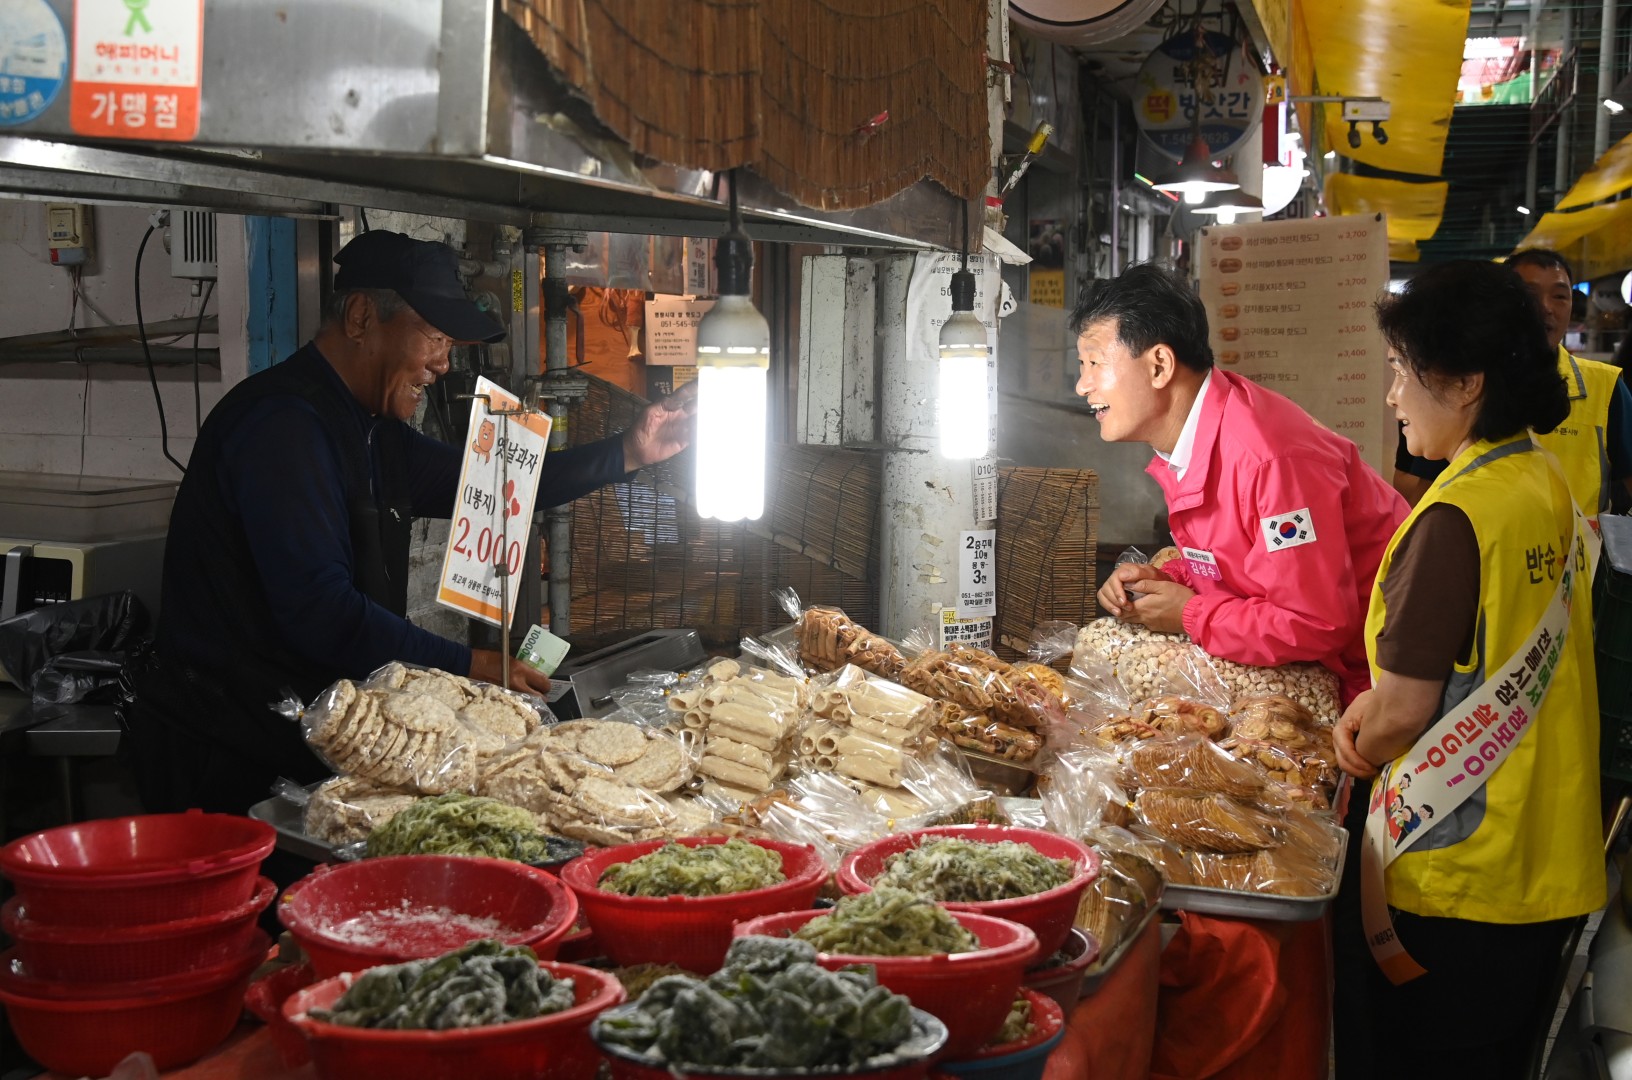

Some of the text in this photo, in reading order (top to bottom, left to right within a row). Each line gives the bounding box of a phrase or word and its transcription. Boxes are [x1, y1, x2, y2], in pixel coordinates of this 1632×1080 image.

[95, 42, 179, 63] 해피머니
[91, 91, 178, 129] 가맹점
[1148, 95, 1169, 119] 떡
[495, 437, 539, 475] 옛날과자
[463, 484, 496, 516] (1봉지)
[453, 516, 521, 576] 2,000
[1189, 561, 1217, 578] 김성수
[522, 629, 541, 656] 10000
[1414, 627, 1552, 774] 전통시장 살리GO!
[1447, 628, 1564, 787] 시장에서 장보GO!
